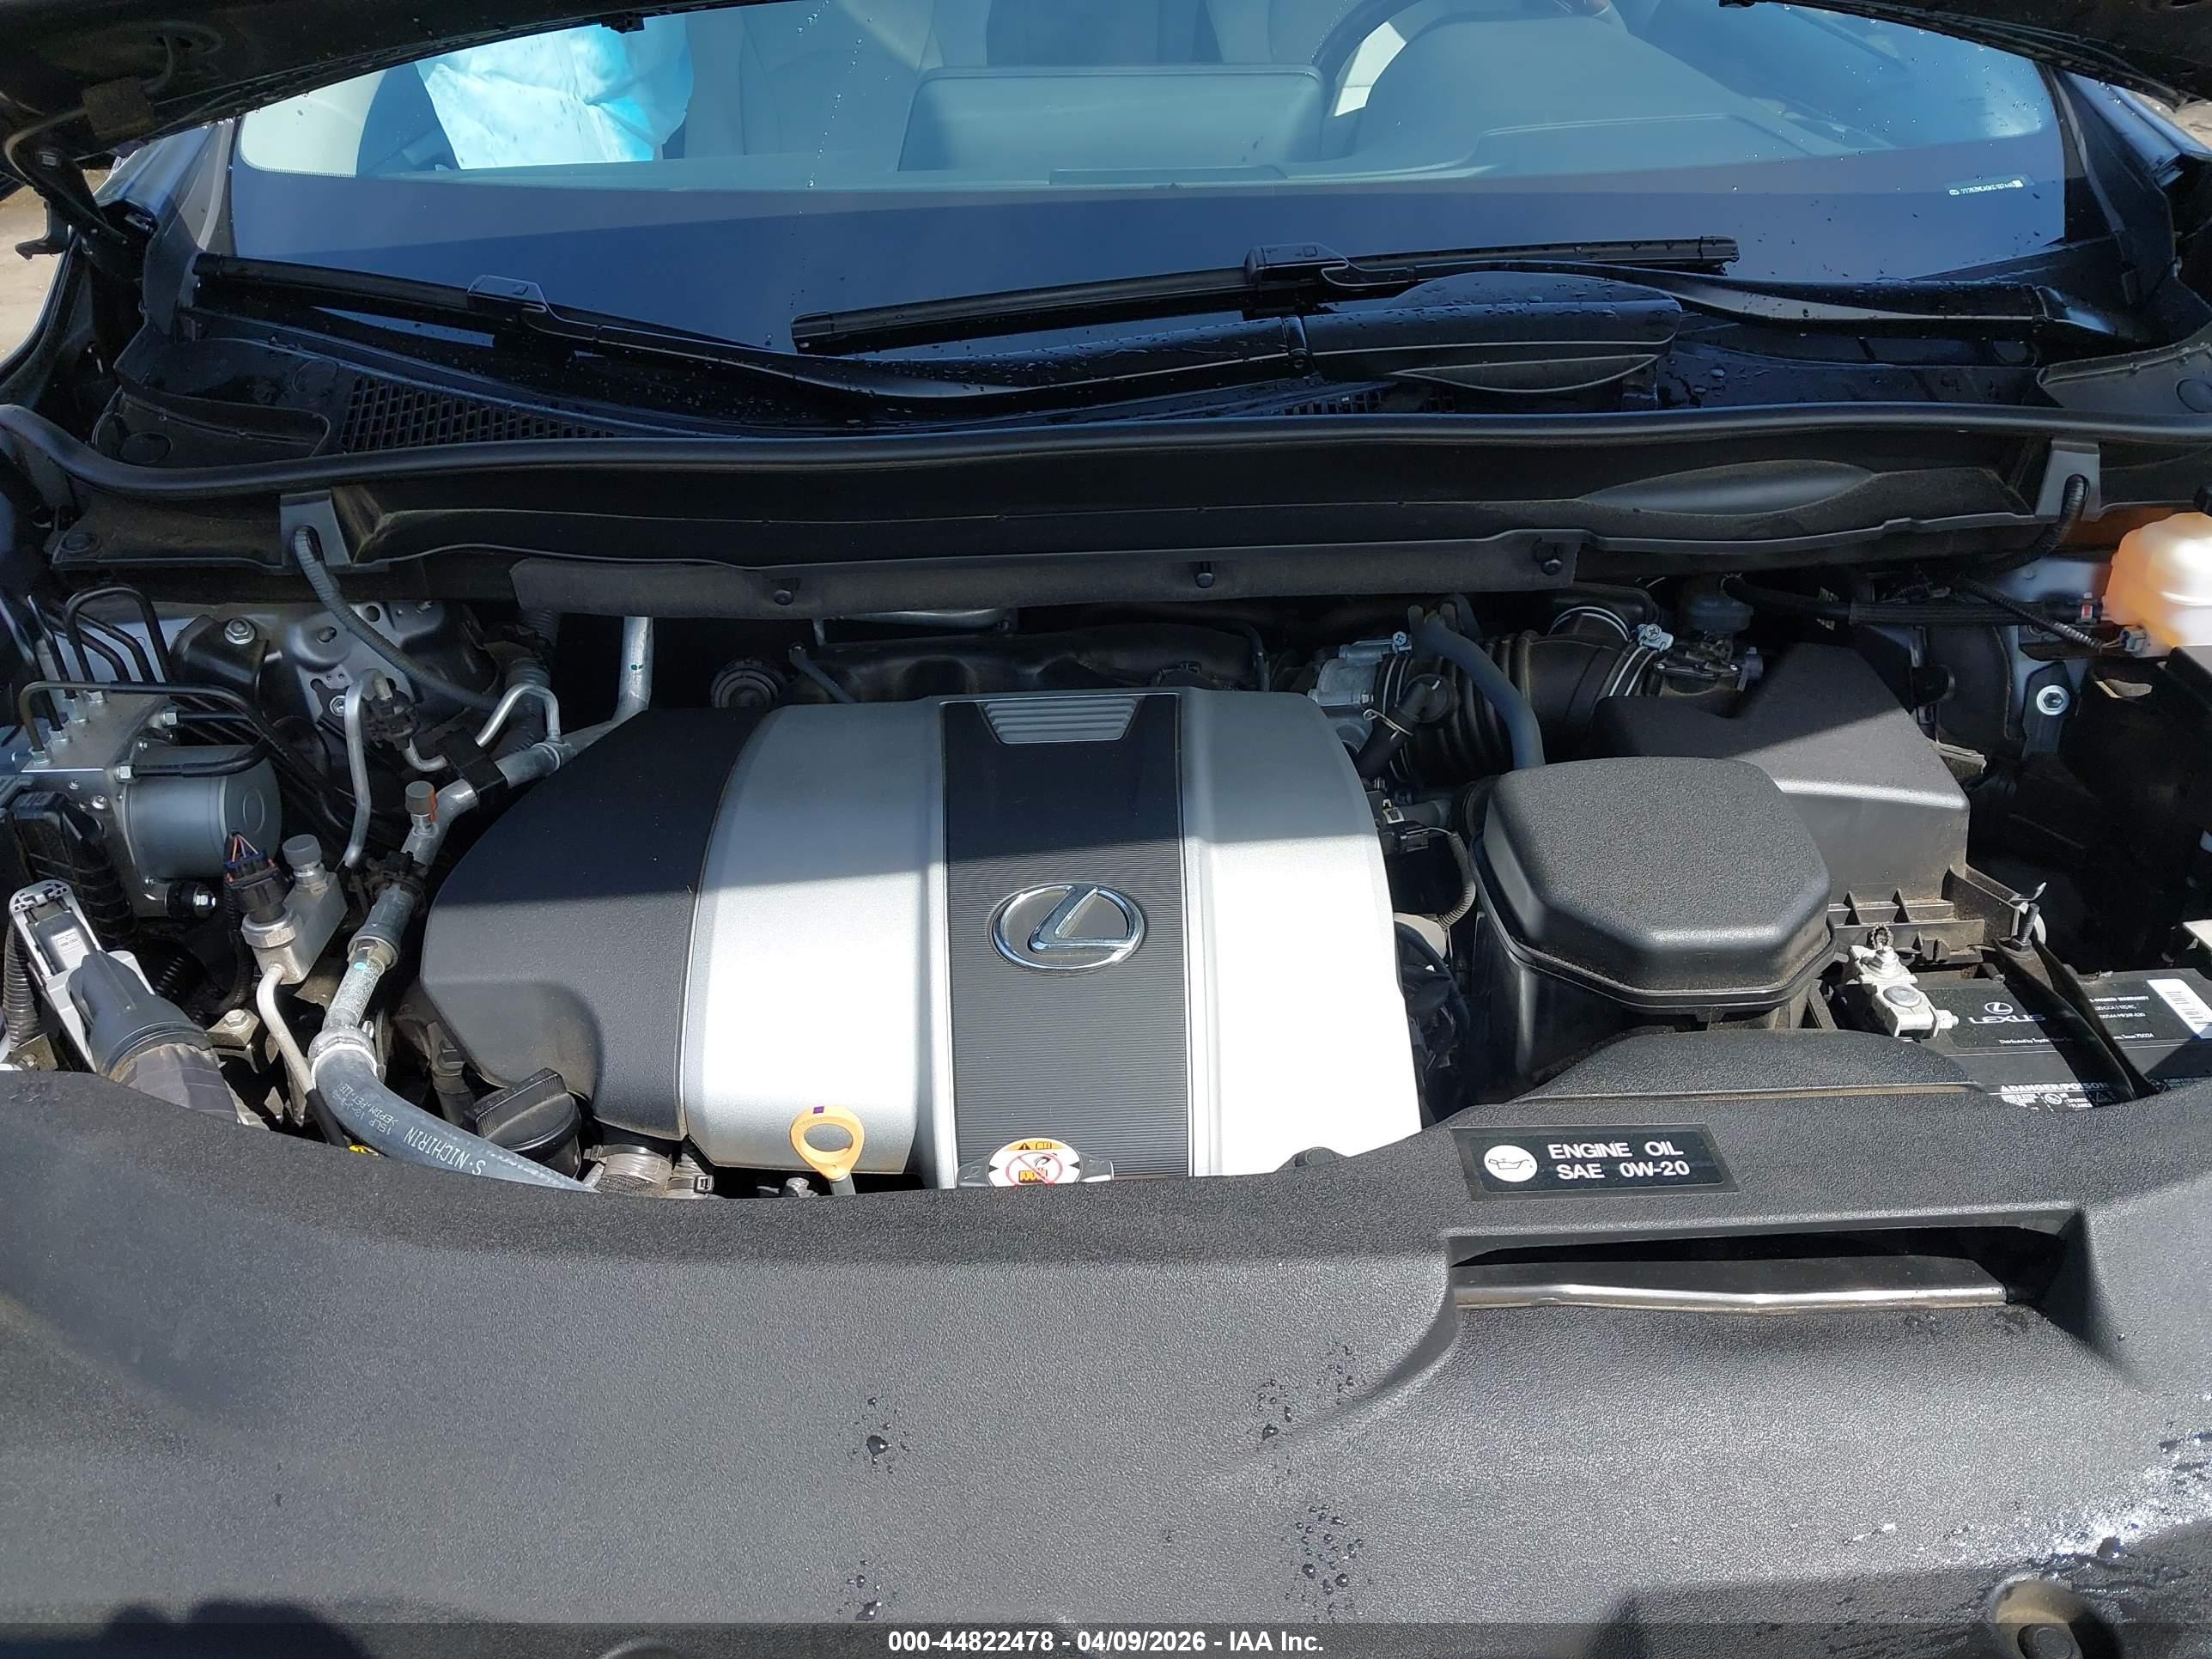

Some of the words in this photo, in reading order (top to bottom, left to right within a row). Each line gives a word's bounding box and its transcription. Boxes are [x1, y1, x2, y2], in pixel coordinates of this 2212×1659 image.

[1968, 1014, 2046, 1024] LEXUS
[1547, 1141, 1633, 1159] ENGINE
[1644, 1140, 1685, 1158] OIL
[1556, 1163, 1605, 1180] SAE
[1619, 1160, 1691, 1178] 0W-20
